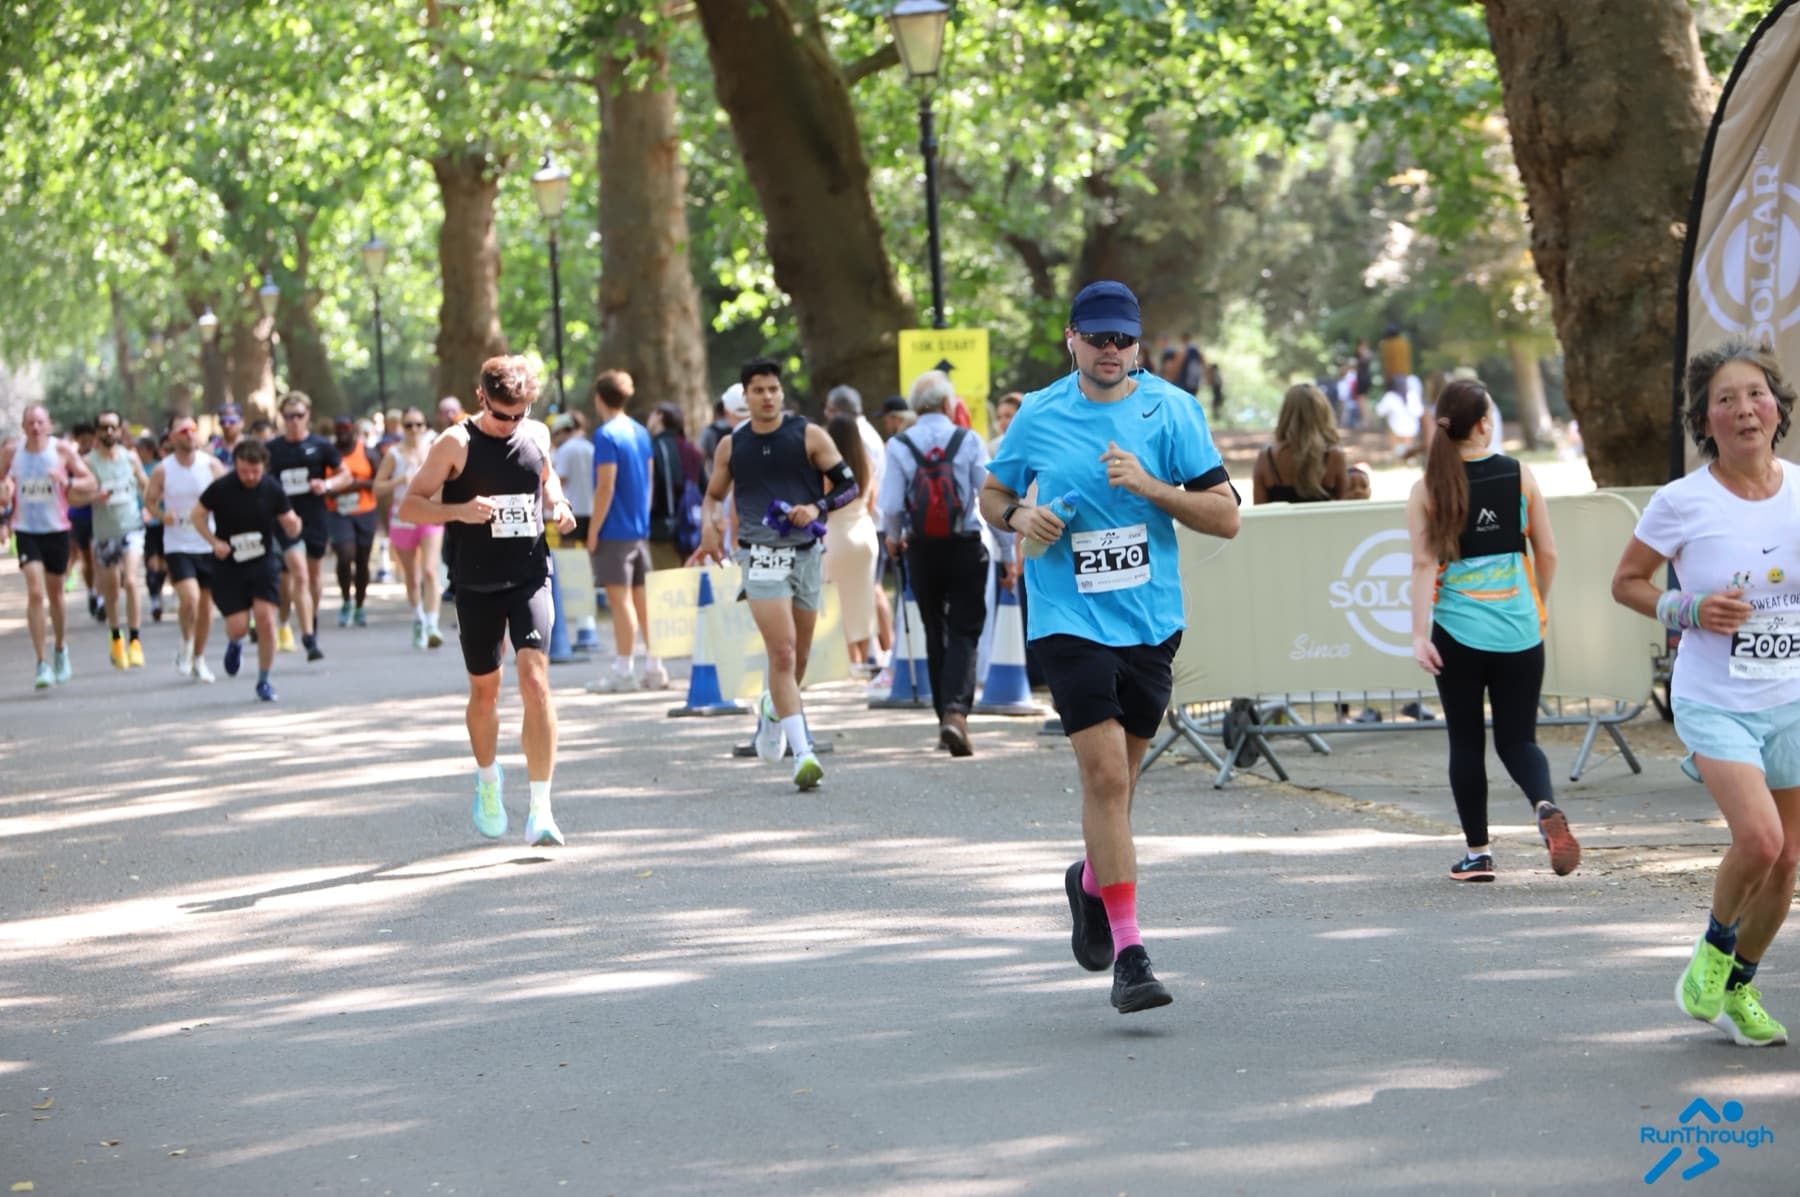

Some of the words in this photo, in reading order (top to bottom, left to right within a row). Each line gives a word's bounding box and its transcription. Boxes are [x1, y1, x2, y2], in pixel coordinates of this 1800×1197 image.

[1750, 162, 1780, 352] SOLGAR
[938, 339, 976, 352] START
[491, 507, 537, 523] 163
[751, 555, 791, 569] 2412
[1079, 545, 1143, 574] 2170
[1749, 594, 1781, 610] SWEAT
[1289, 633, 1352, 661] Since
